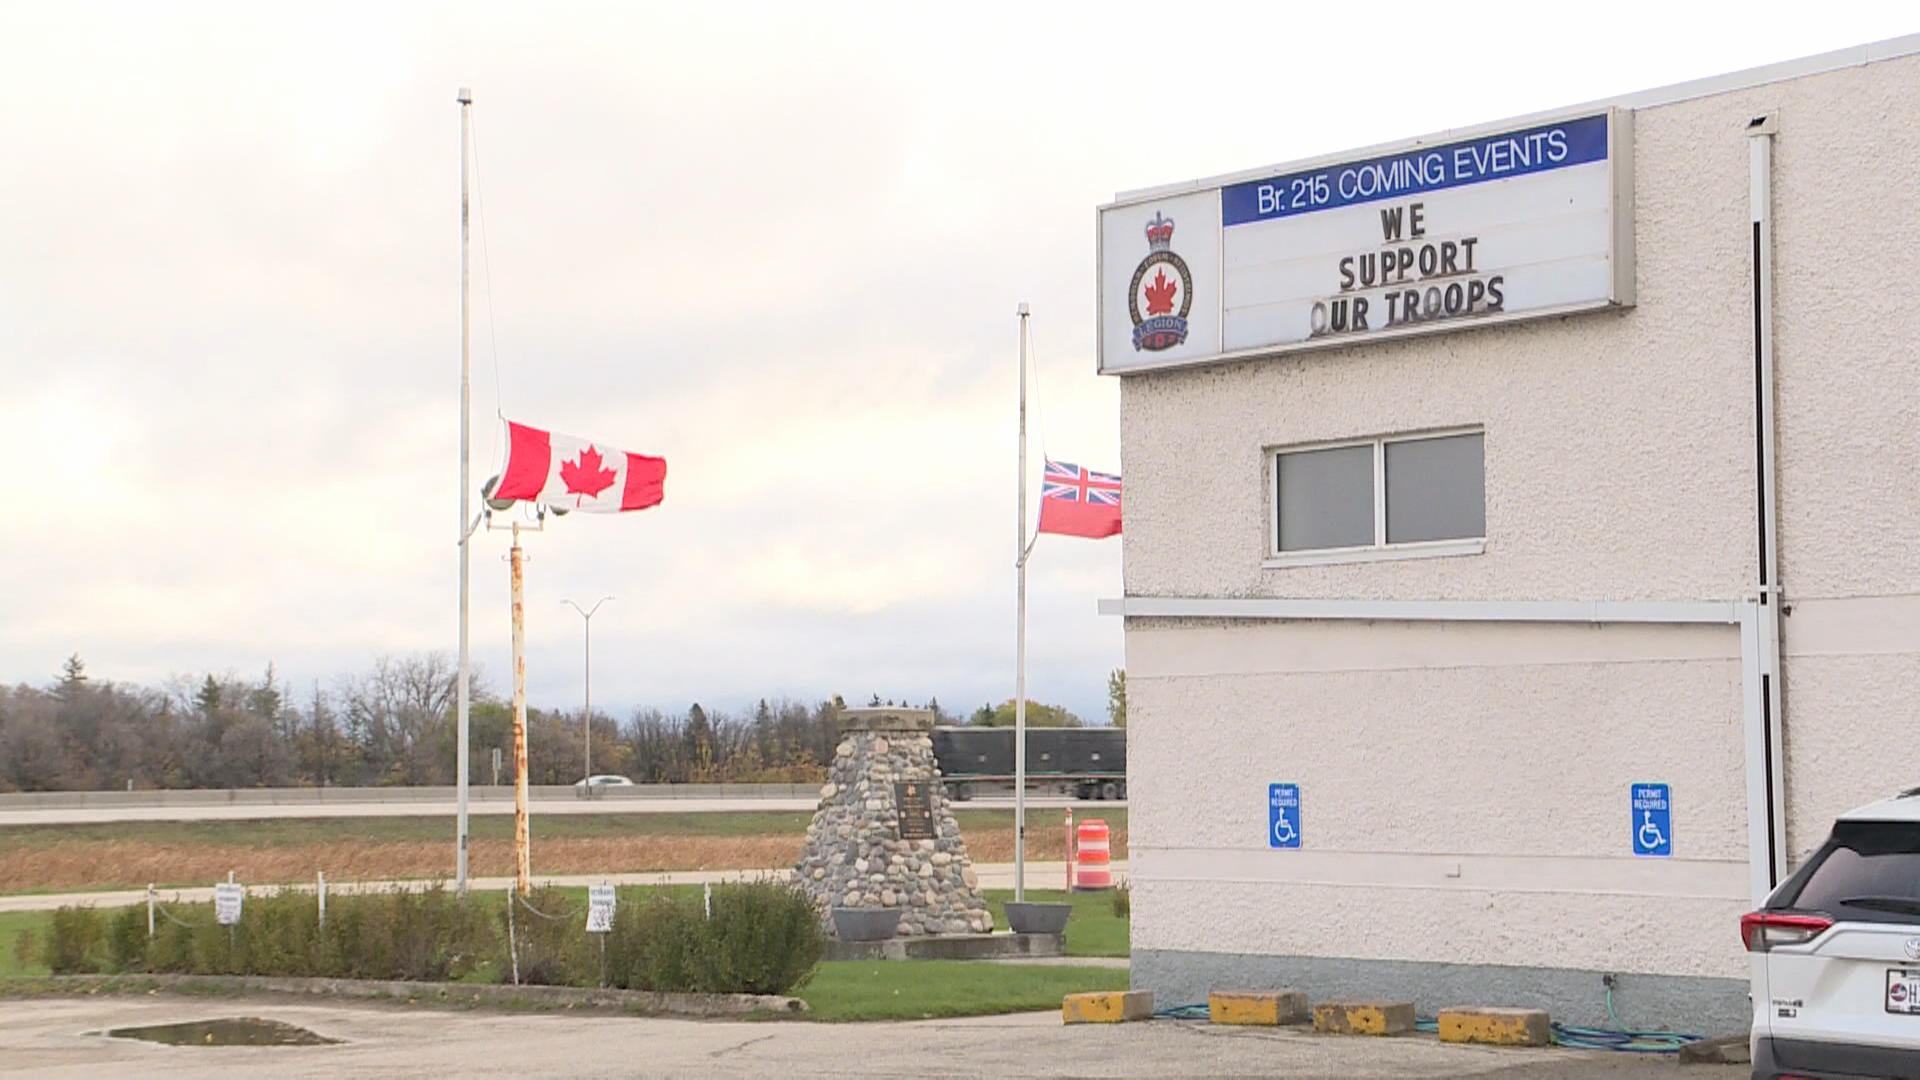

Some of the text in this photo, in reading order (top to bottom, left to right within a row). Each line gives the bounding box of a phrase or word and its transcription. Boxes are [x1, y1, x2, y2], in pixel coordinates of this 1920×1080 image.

[1258, 129, 1568, 214] Br. 215 COMING EVENTS
[1381, 203, 1425, 240] WE
[1339, 237, 1478, 289] SUPPORT
[1311, 276, 1504, 334] OUR TROOPS
[1140, 318, 1182, 336] LEGION
[1274, 789, 1294, 797] PERMIT
[1638, 789, 1662, 798] PERMIT
[1271, 798, 1298, 807] REQUIRED
[1634, 799, 1667, 810] REQUIRED
